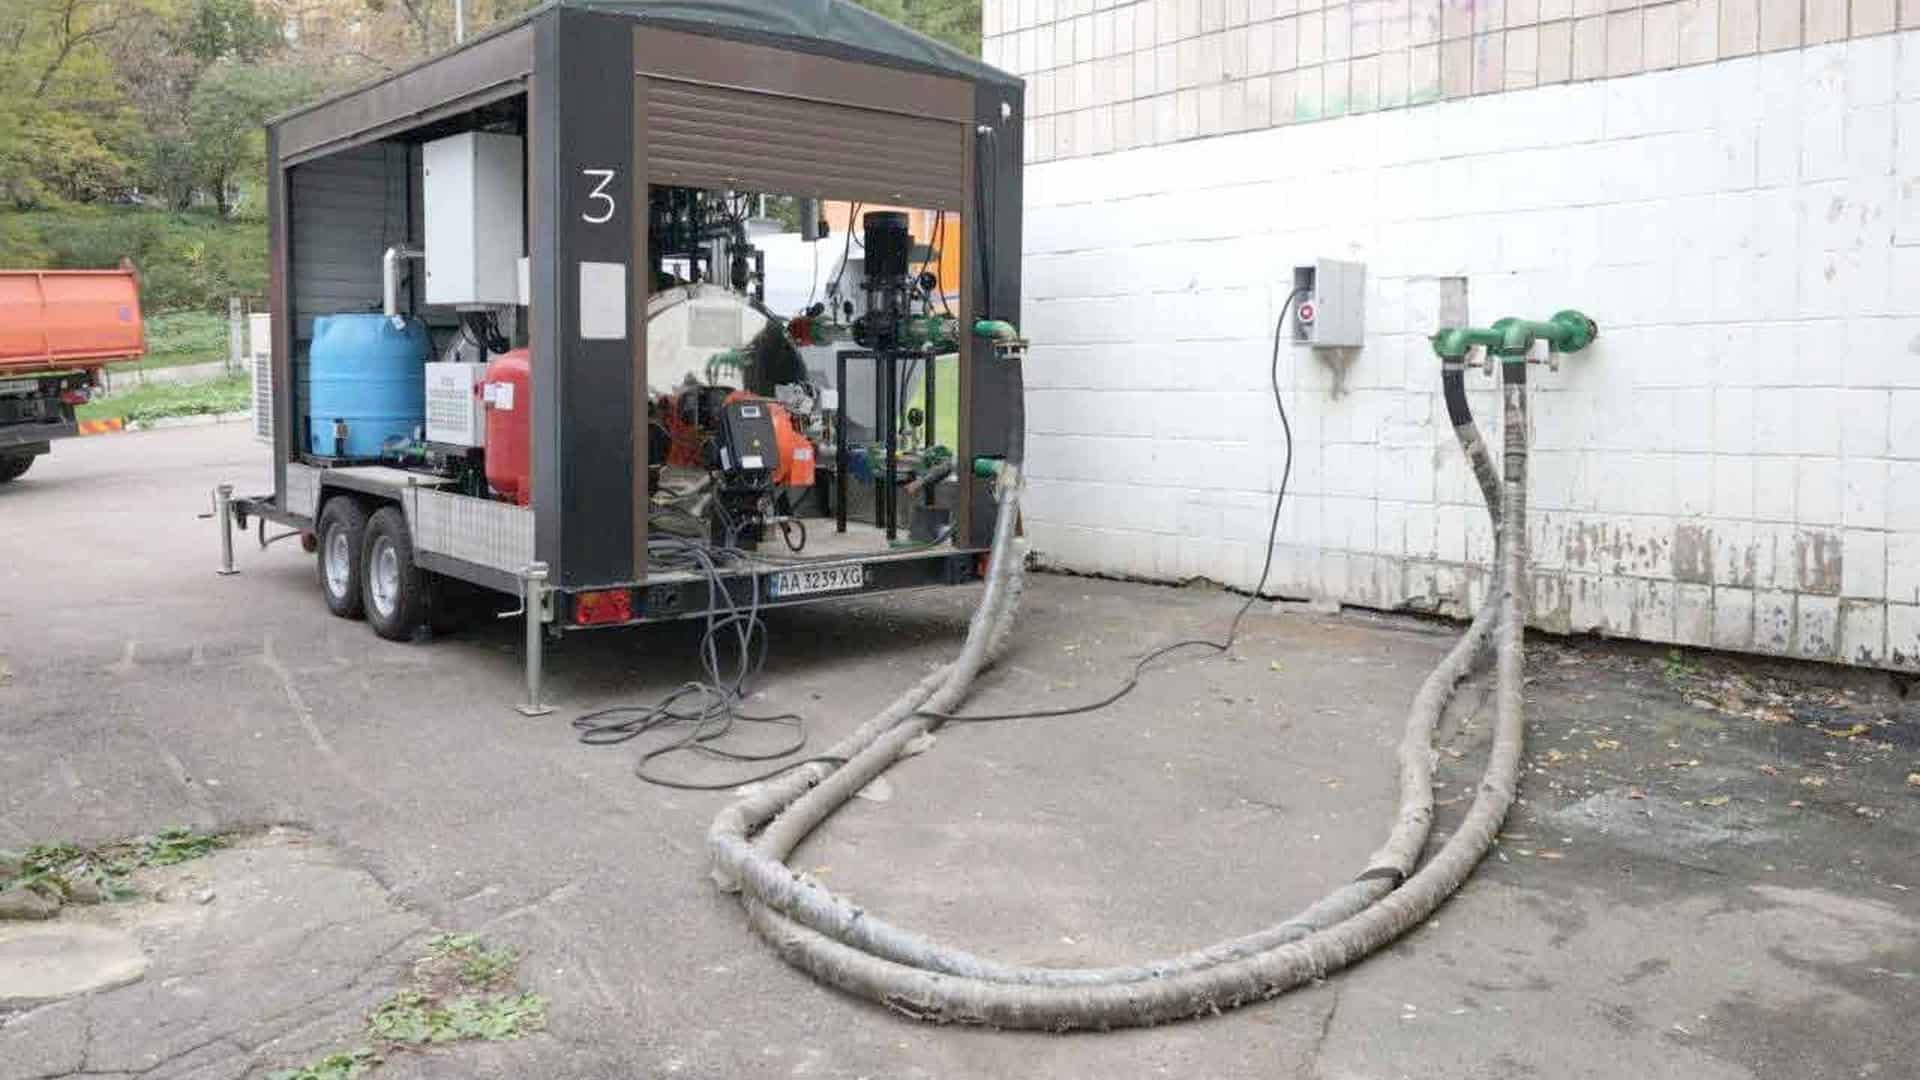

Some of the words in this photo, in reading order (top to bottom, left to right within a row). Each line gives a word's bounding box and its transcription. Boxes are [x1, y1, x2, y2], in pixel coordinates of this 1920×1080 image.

[582, 170, 615, 223] 3
[780, 572, 800, 592] AA
[803, 569, 837, 589] 3239
[840, 566, 861, 585] XG
